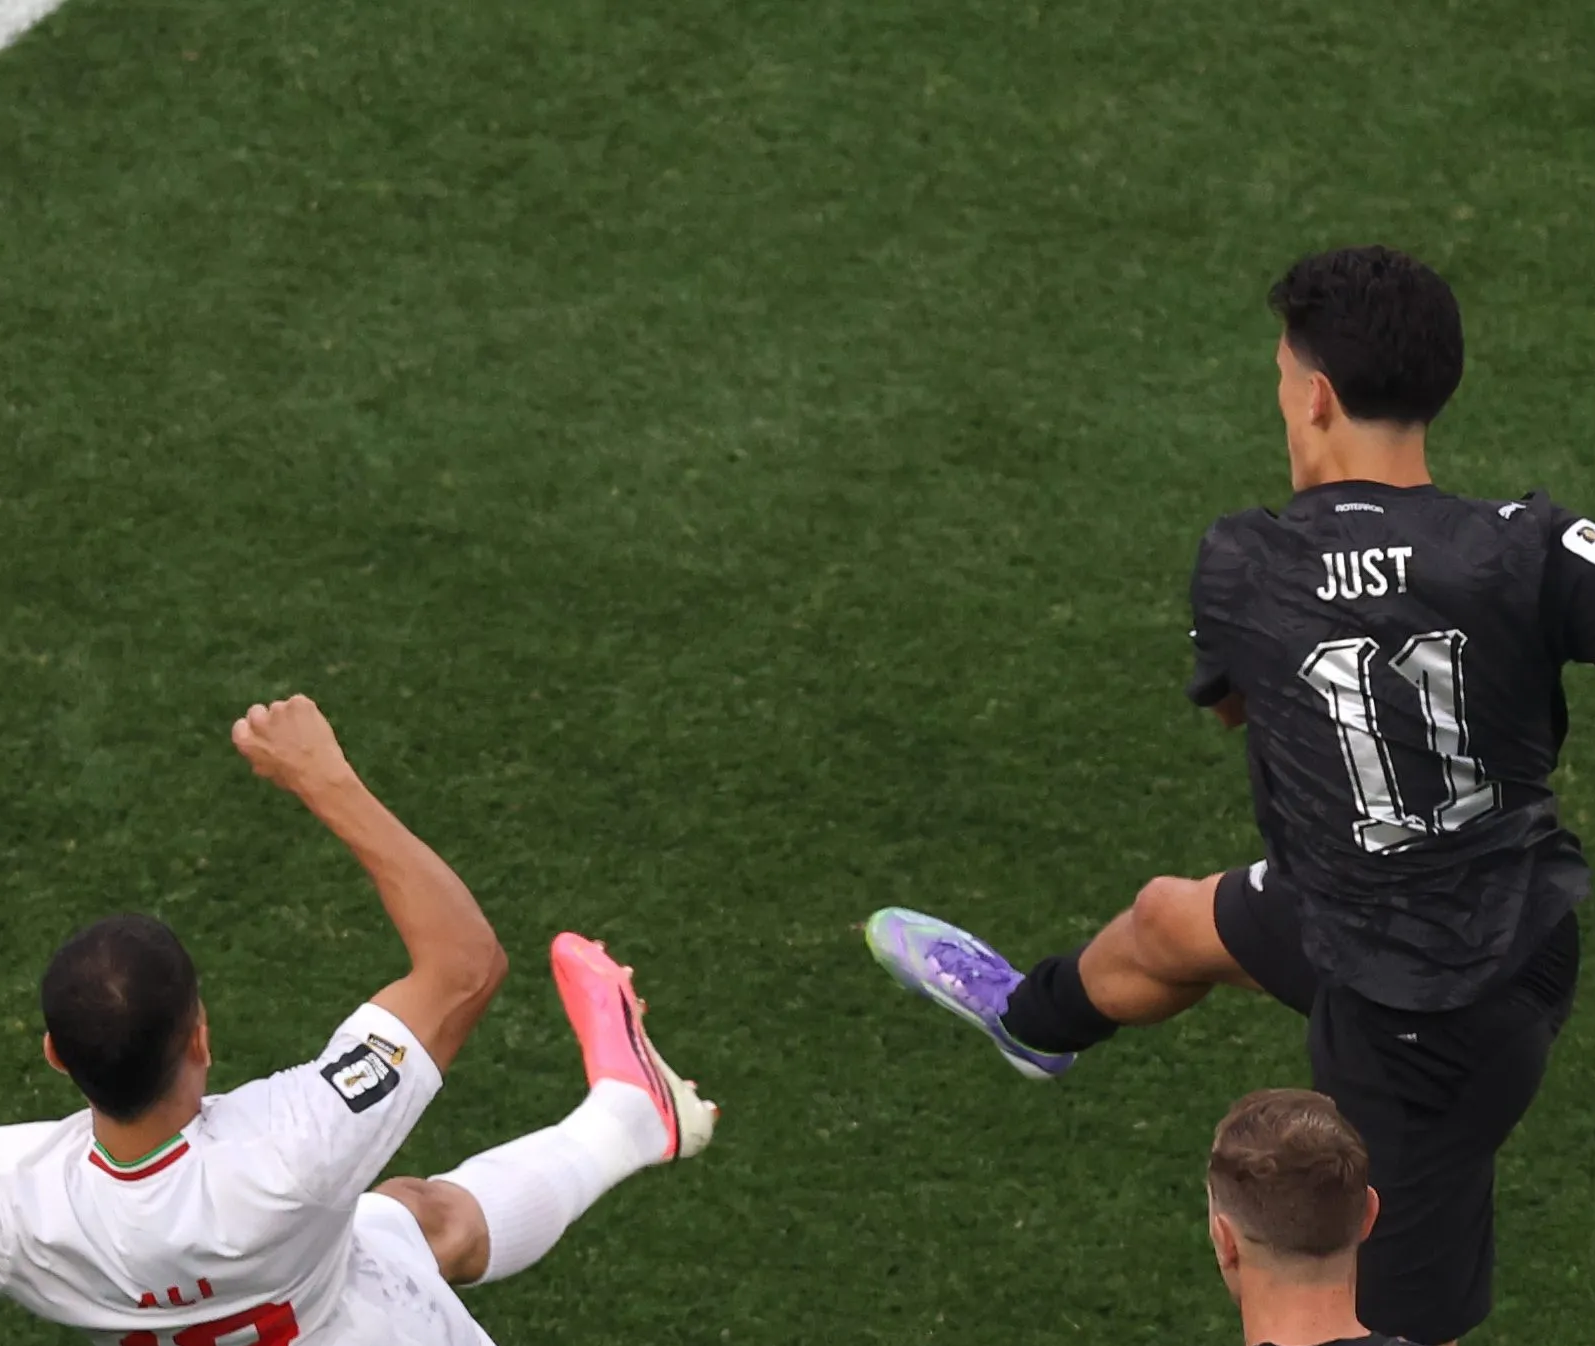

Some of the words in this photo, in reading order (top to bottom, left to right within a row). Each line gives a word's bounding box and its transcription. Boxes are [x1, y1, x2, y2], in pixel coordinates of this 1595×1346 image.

[1316, 547, 1412, 600] JUST
[1297, 629, 1503, 855] 11
[138, 1278, 213, 1308] ALI
